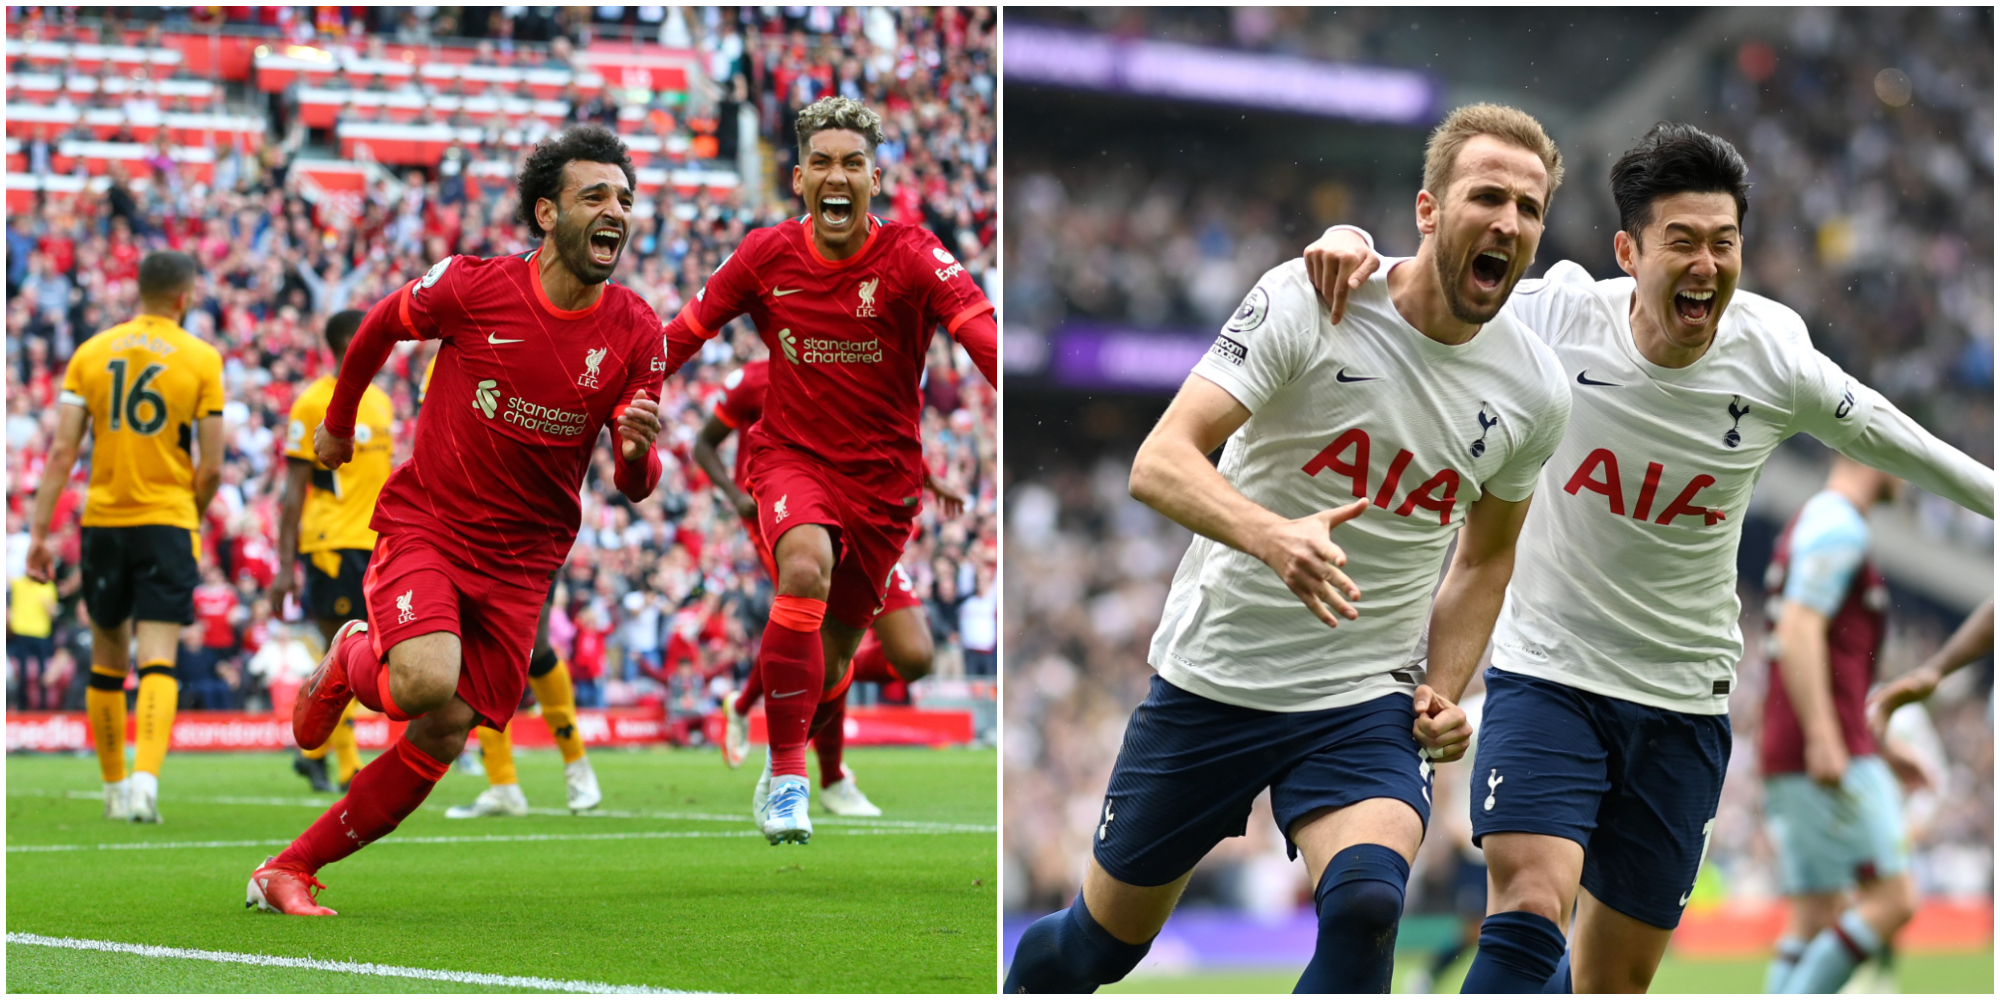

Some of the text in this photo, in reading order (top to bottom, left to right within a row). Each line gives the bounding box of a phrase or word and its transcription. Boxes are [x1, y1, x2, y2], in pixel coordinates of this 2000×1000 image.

[803, 337, 879, 353] standard
[803, 349, 883, 364] chartered
[106, 358, 169, 437] 16
[507, 397, 589, 424] standard
[503, 410, 587, 436] chartered
[1301, 428, 1460, 526] AIA
[1563, 447, 1726, 527] AIA
[173, 716, 280, 748] standard
